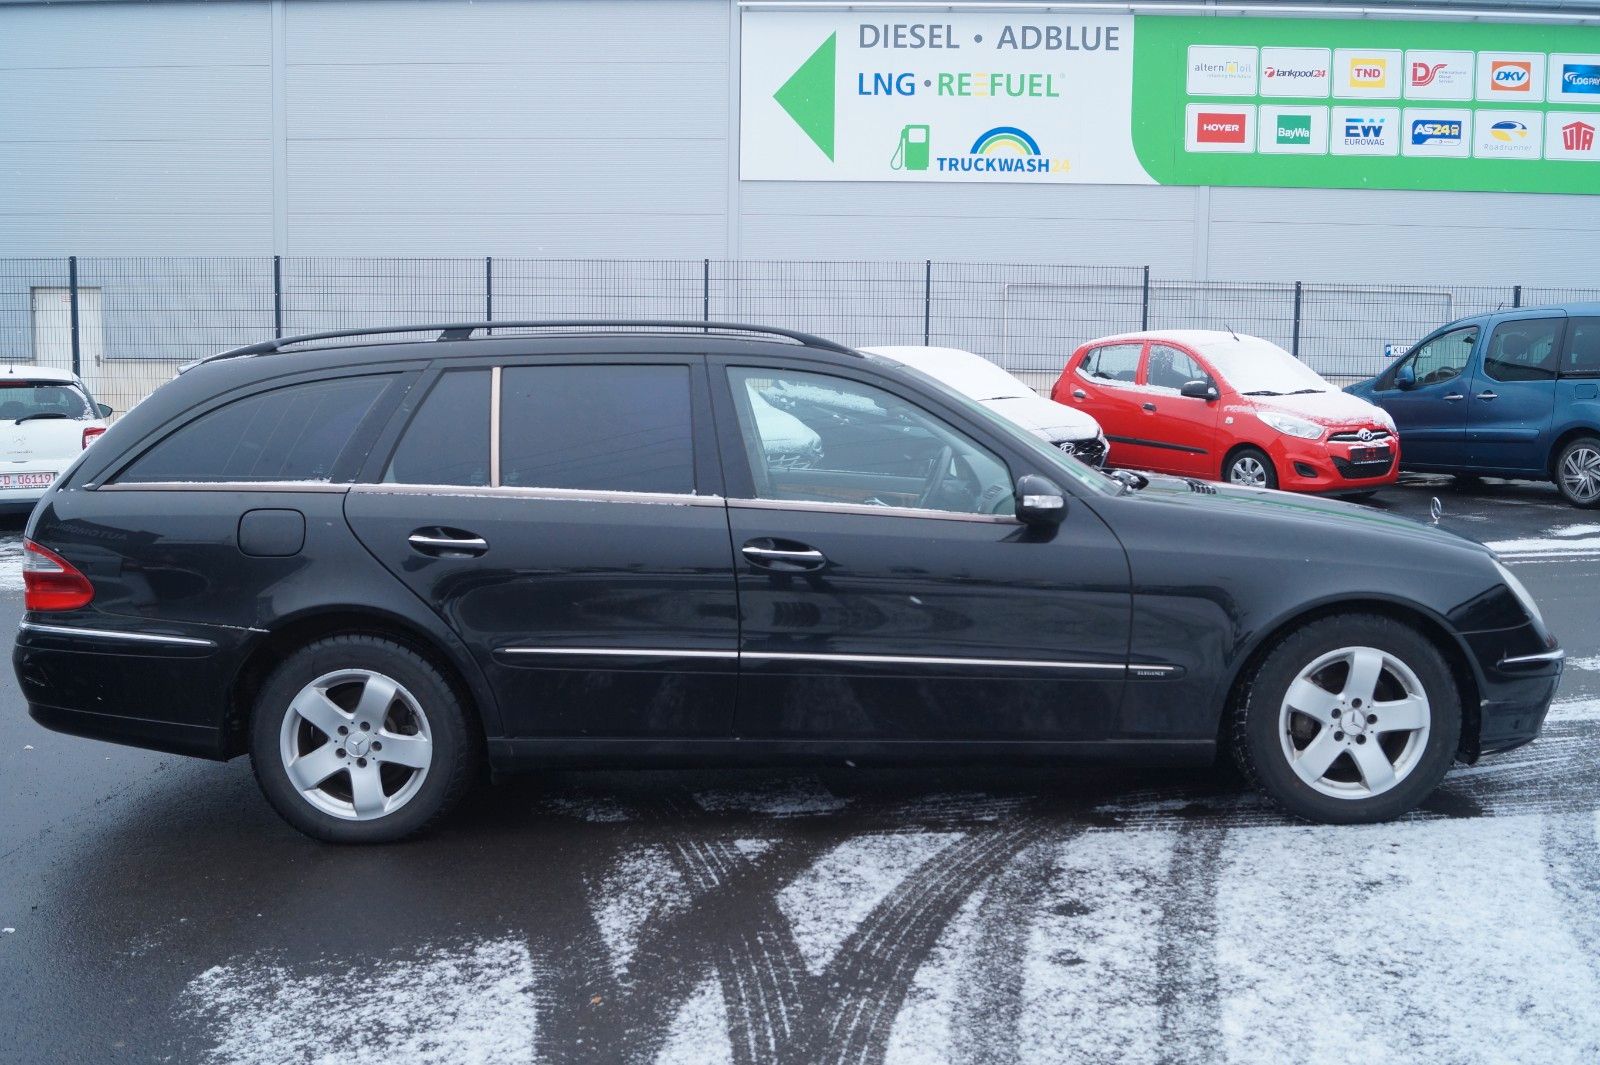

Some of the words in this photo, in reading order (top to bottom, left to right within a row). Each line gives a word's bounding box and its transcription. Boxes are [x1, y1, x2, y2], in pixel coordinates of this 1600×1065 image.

[859, 24, 960, 49] DIESEL
[997, 26, 1120, 51] ADBLUE
[1276, 68, 1326, 80] tankpool24
[1355, 68, 1381, 78] TND
[1495, 71, 1526, 81] DKV
[858, 72, 915, 97] LNG
[1203, 123, 1240, 132] HOYER
[1278, 127, 1310, 140] BayWa
[1344, 138, 1385, 146] EUROWAG
[1562, 121, 1596, 151] UTA
[1483, 143, 1532, 151] Roadrunner
[18, 473, 51, 485] 06119
